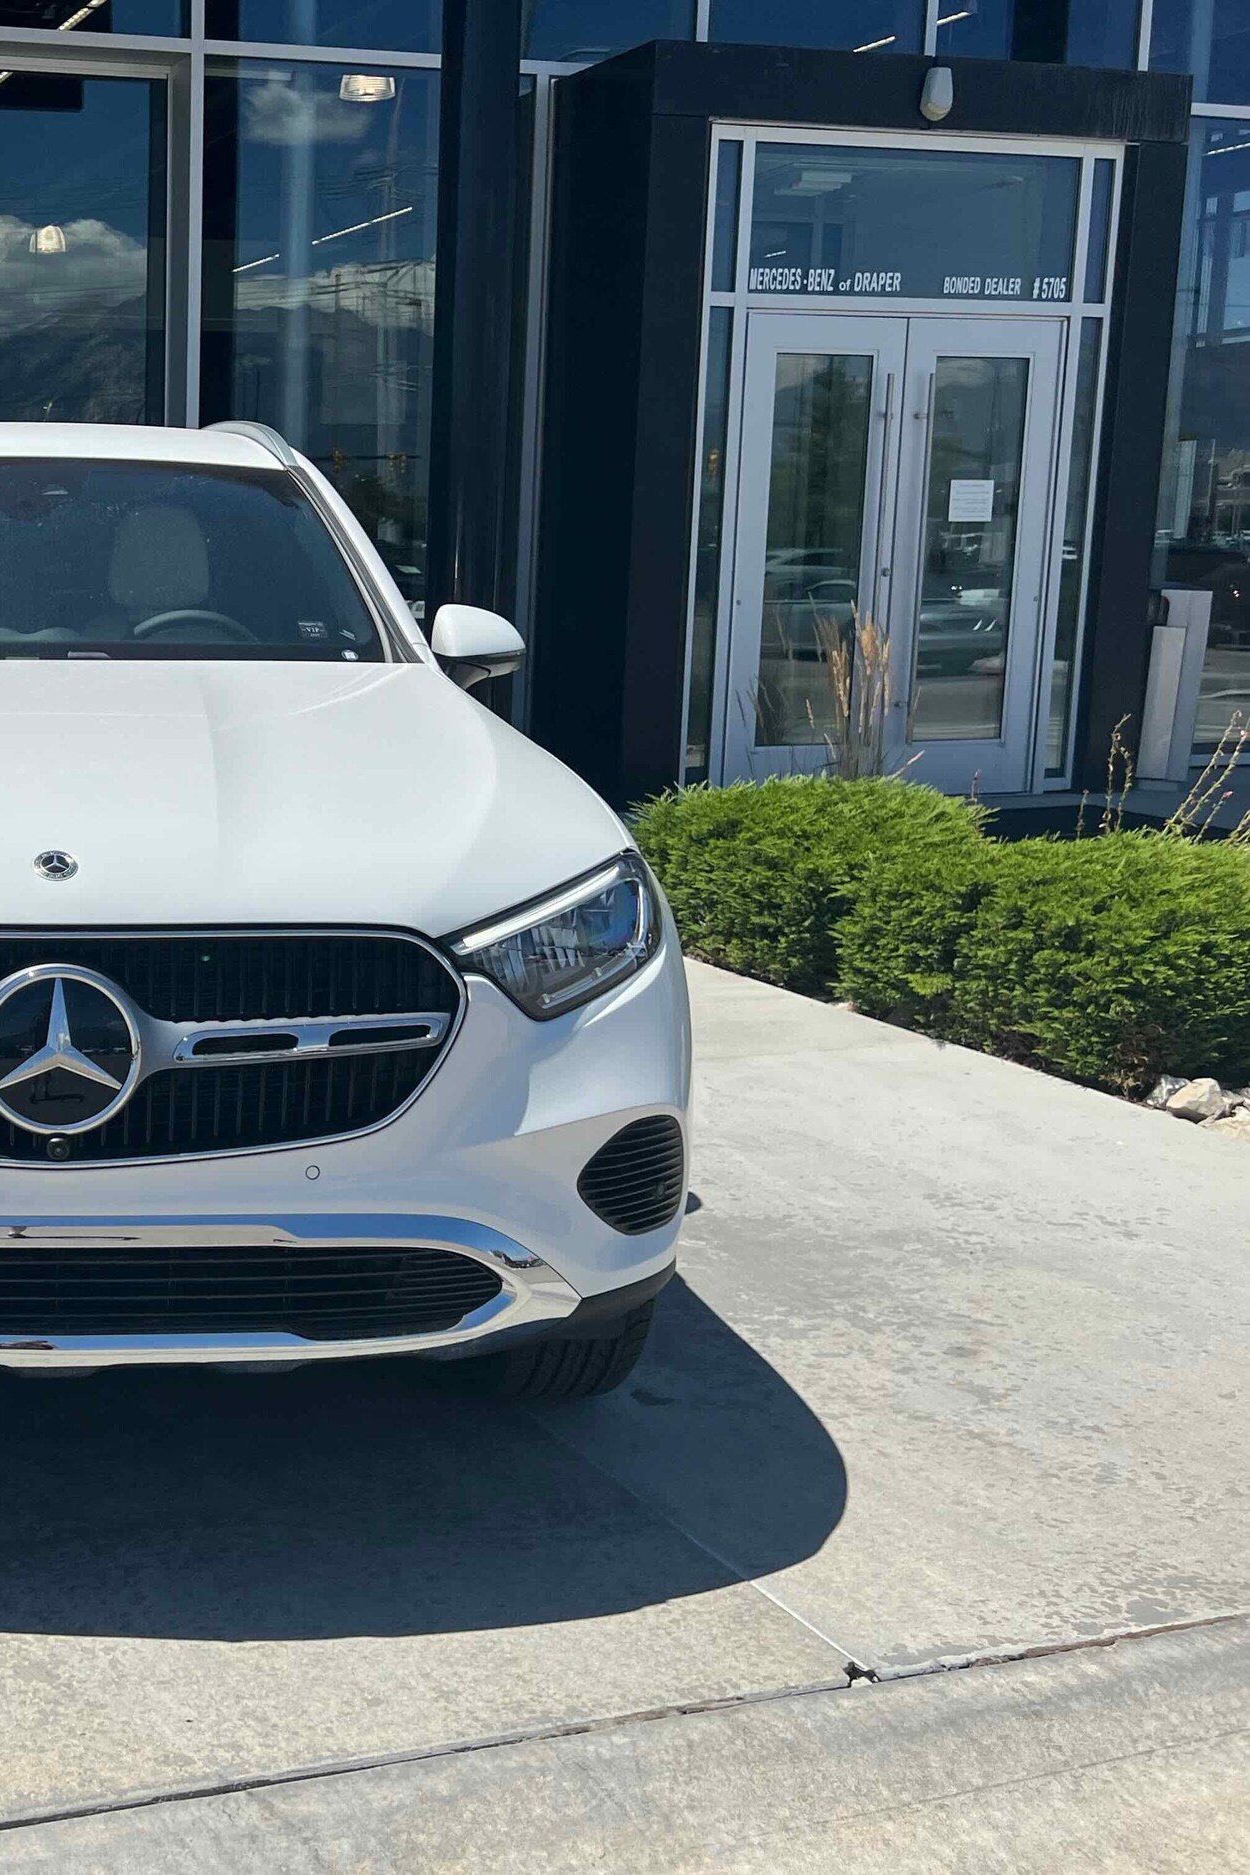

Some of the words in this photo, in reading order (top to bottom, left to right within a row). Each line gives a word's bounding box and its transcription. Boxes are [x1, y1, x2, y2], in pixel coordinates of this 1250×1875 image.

[838, 279, 851, 291] of
[854, 272, 901, 292] DRAPER
[943, 276, 981, 294] BONDED
[984, 278, 1021, 295] DEALER
